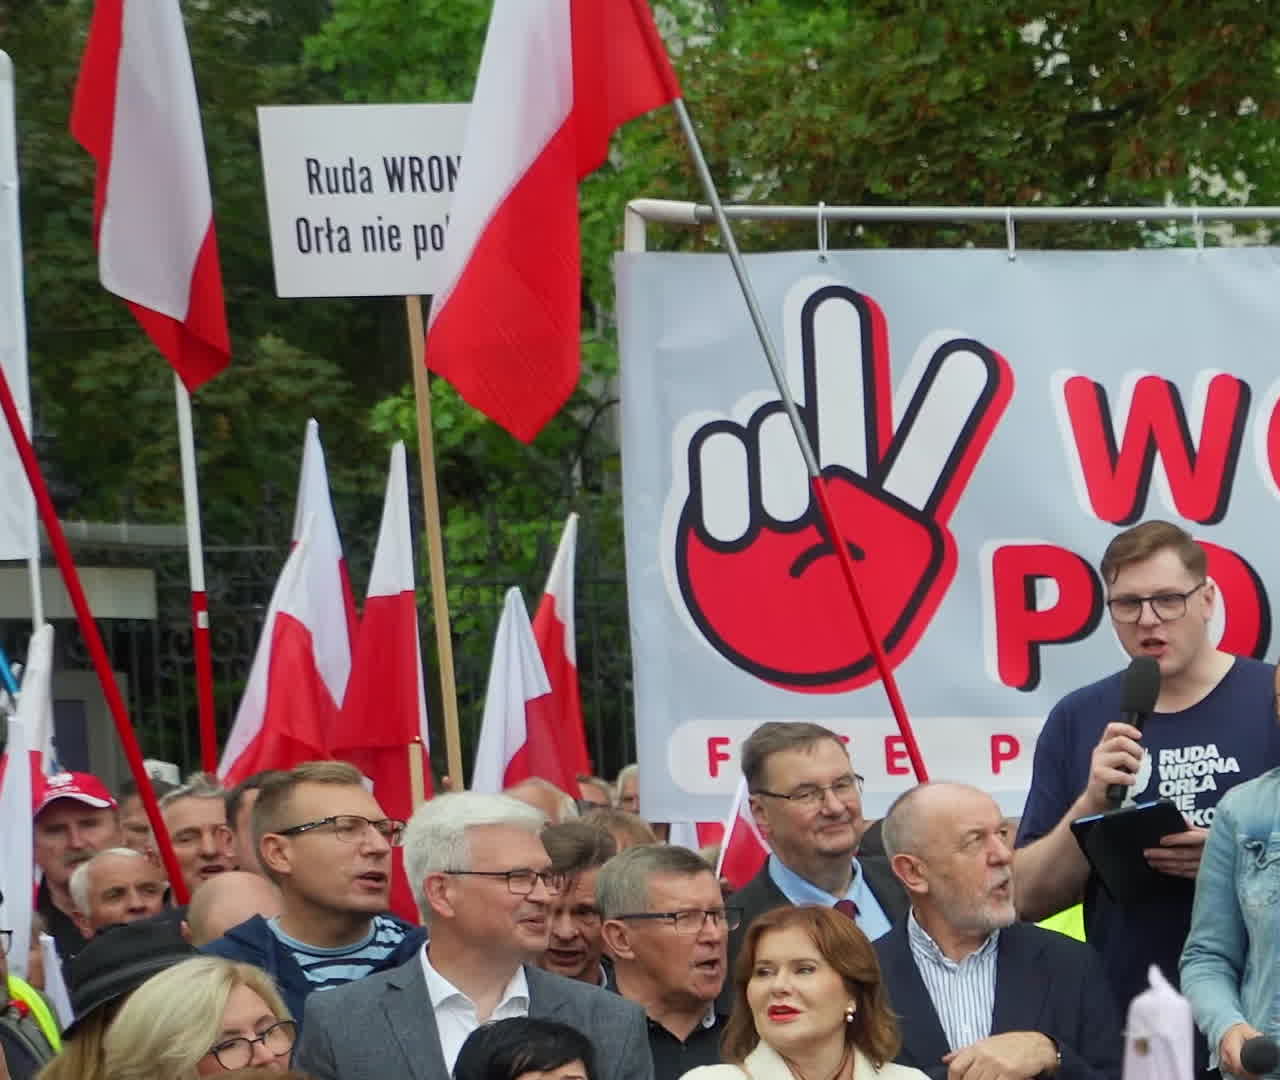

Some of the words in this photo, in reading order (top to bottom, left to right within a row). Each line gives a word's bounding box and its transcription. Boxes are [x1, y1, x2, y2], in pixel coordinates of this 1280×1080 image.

[305, 157, 374, 195] Ruda
[296, 216, 352, 255] Orła
[361, 215, 402, 253] nie
[1159, 743, 1220, 765] RUDA
[1158, 756, 1241, 781] WRONA
[1159, 773, 1218, 797] ORŁA
